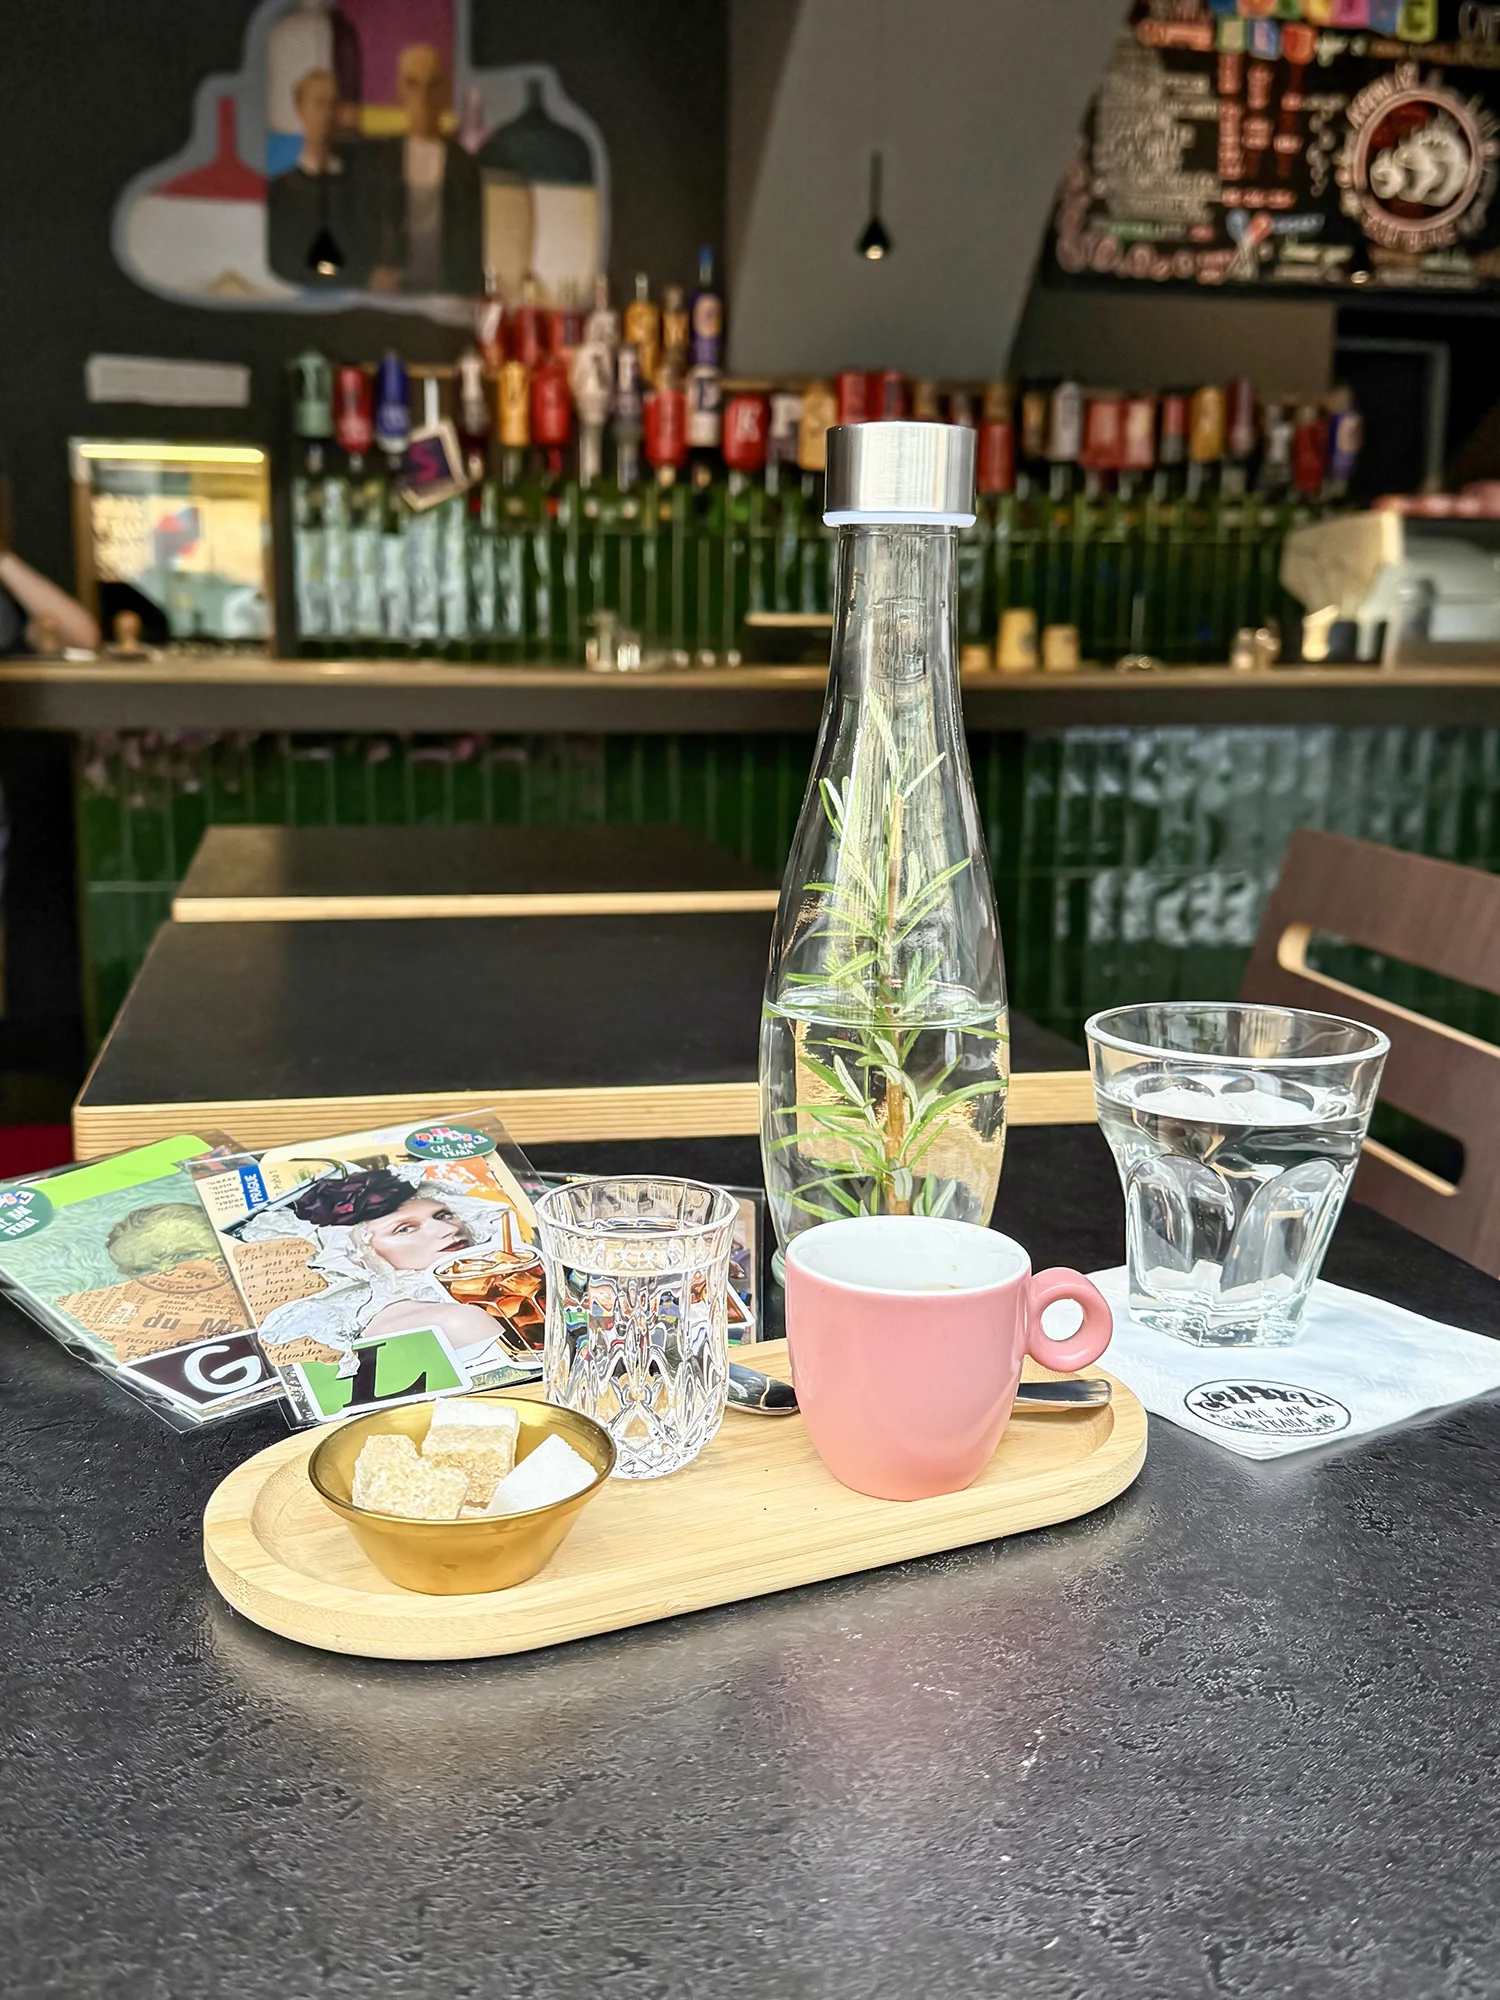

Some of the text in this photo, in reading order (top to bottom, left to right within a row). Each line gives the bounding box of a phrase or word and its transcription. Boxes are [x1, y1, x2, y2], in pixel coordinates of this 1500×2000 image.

[244, 1173, 264, 1203] PRAGUE
[142, 1312, 181, 1331] du
[184, 1345, 262, 1394] G
[342, 1341, 427, 1408] L
